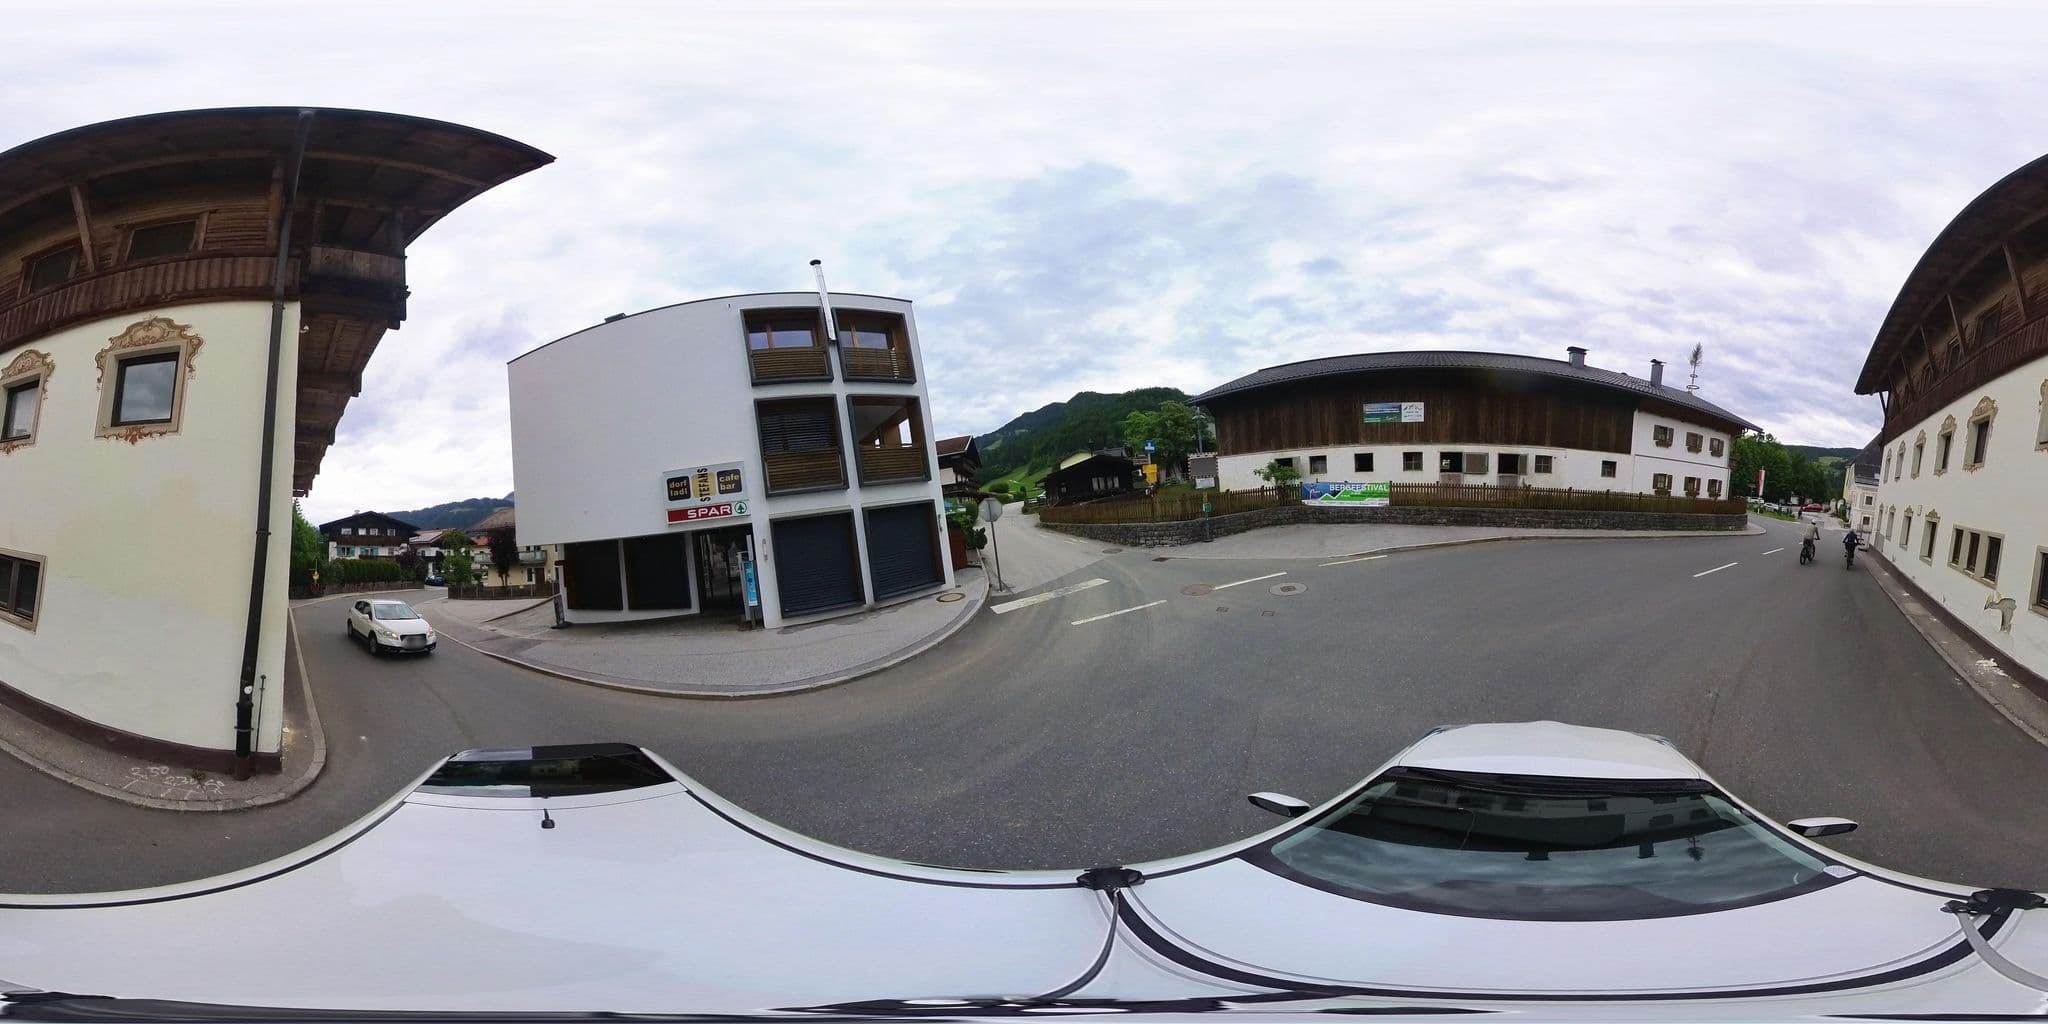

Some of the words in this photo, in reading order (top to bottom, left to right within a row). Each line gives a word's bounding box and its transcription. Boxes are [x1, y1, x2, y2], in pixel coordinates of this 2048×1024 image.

[719, 473, 740, 483] cafe
[669, 480, 687, 489] dorf
[697, 468, 711, 502] STEFANS
[720, 482, 736, 491] bar
[687, 505, 732, 519] SPAR
